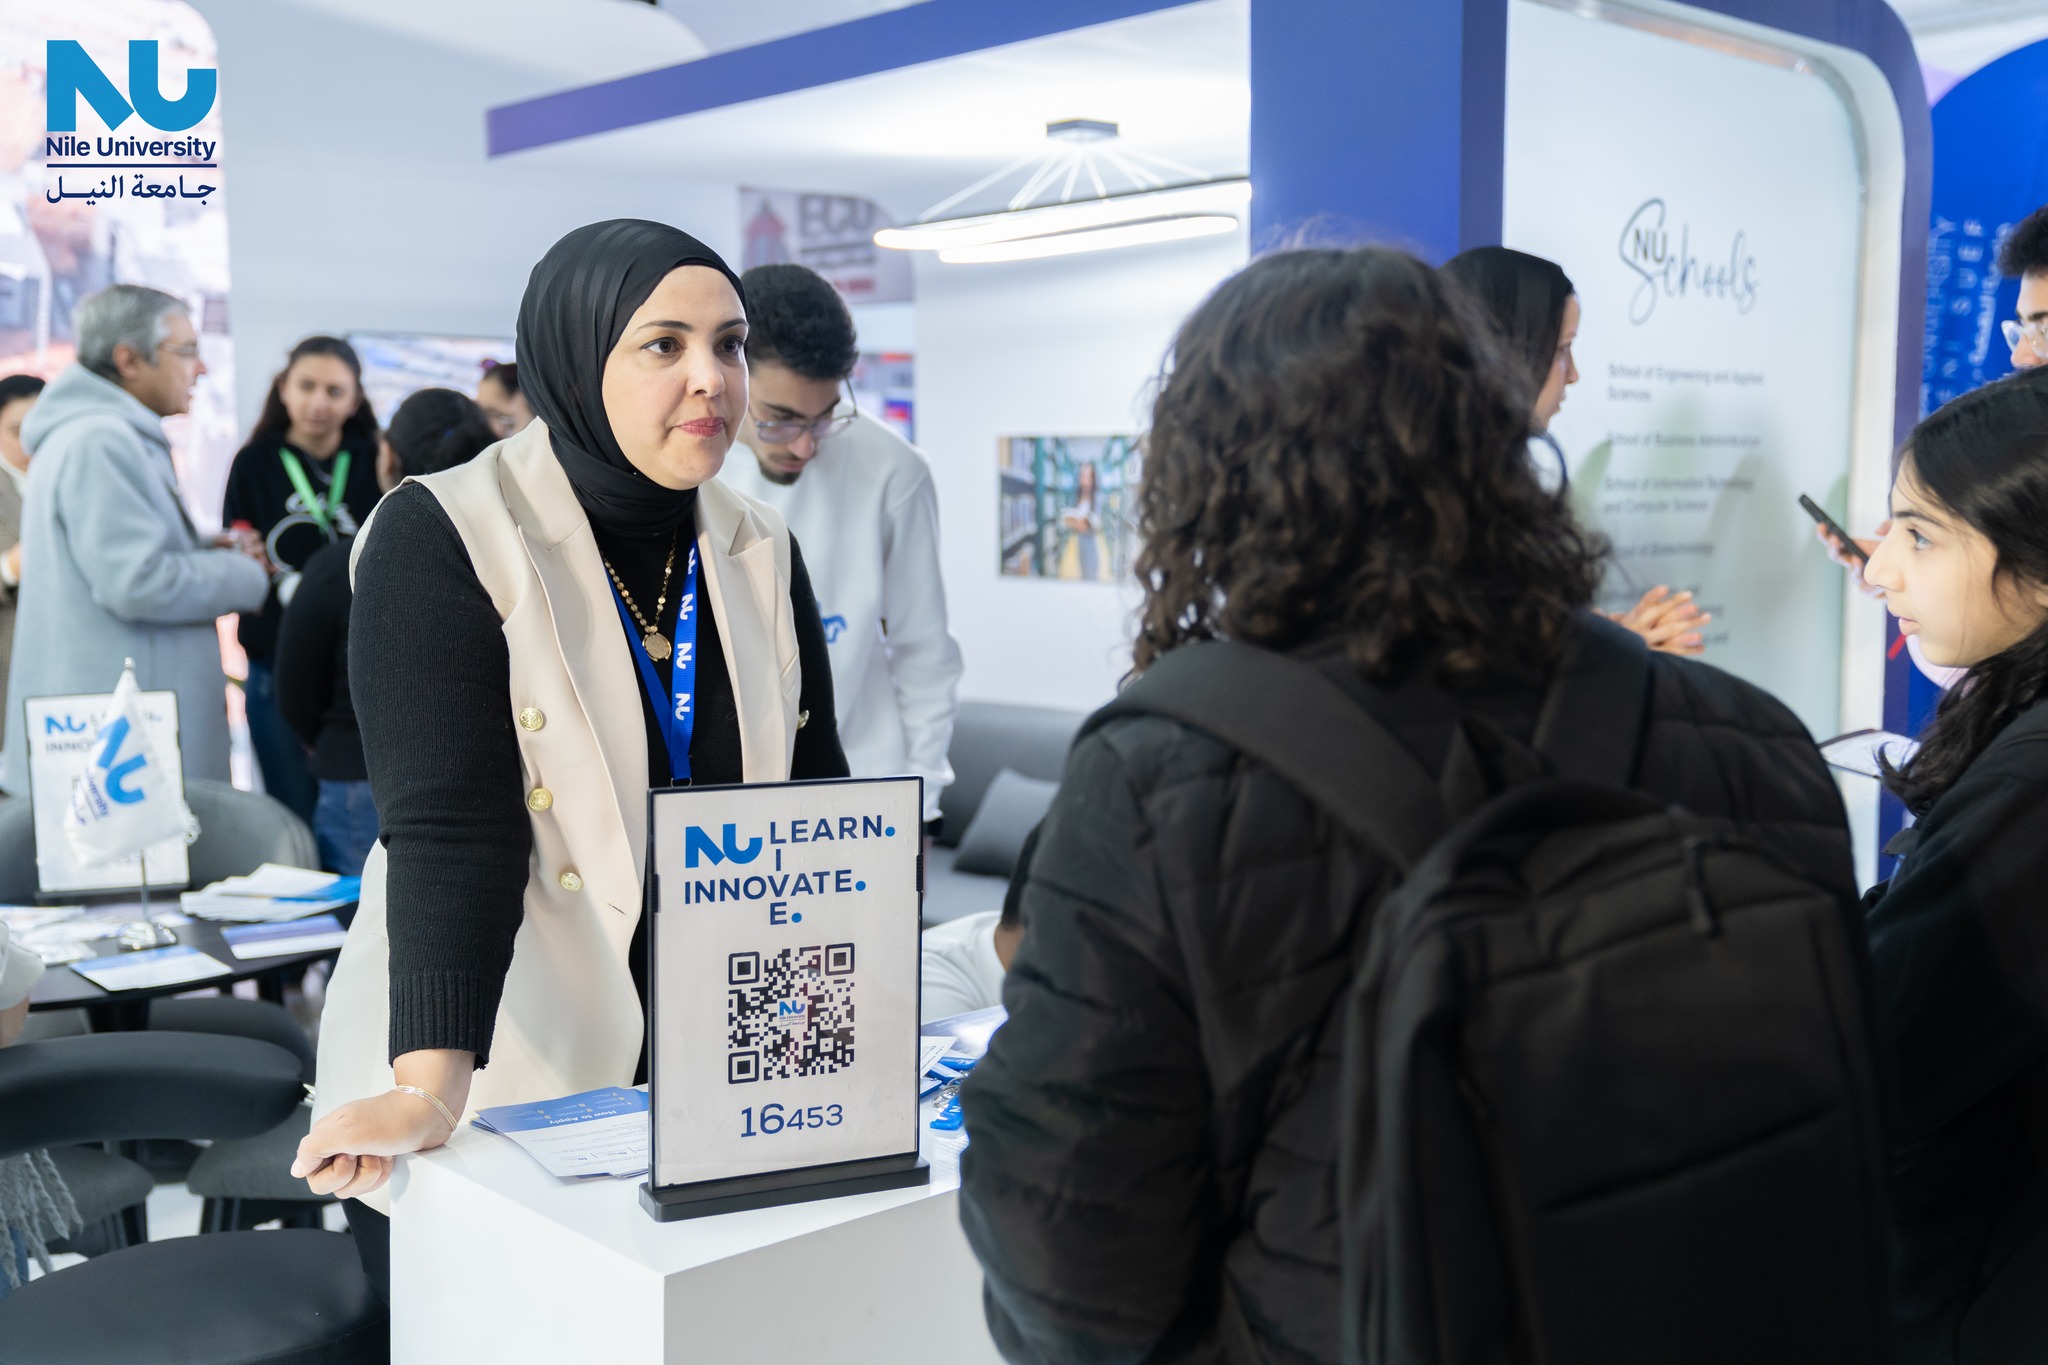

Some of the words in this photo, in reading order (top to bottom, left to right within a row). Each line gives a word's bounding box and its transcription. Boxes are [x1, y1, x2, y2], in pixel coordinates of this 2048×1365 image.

[1634, 228, 1667, 263] NU
[676, 642, 692, 670] NU
[675, 692, 690, 721] NU
[45, 714, 86, 734] NU
[685, 823, 763, 869] NU
[770, 814, 896, 845] LEARN.
[684, 869, 867, 905] INNOVATE.
[779, 1000, 805, 1015] NU
[741, 1103, 844, 1138] 16453
